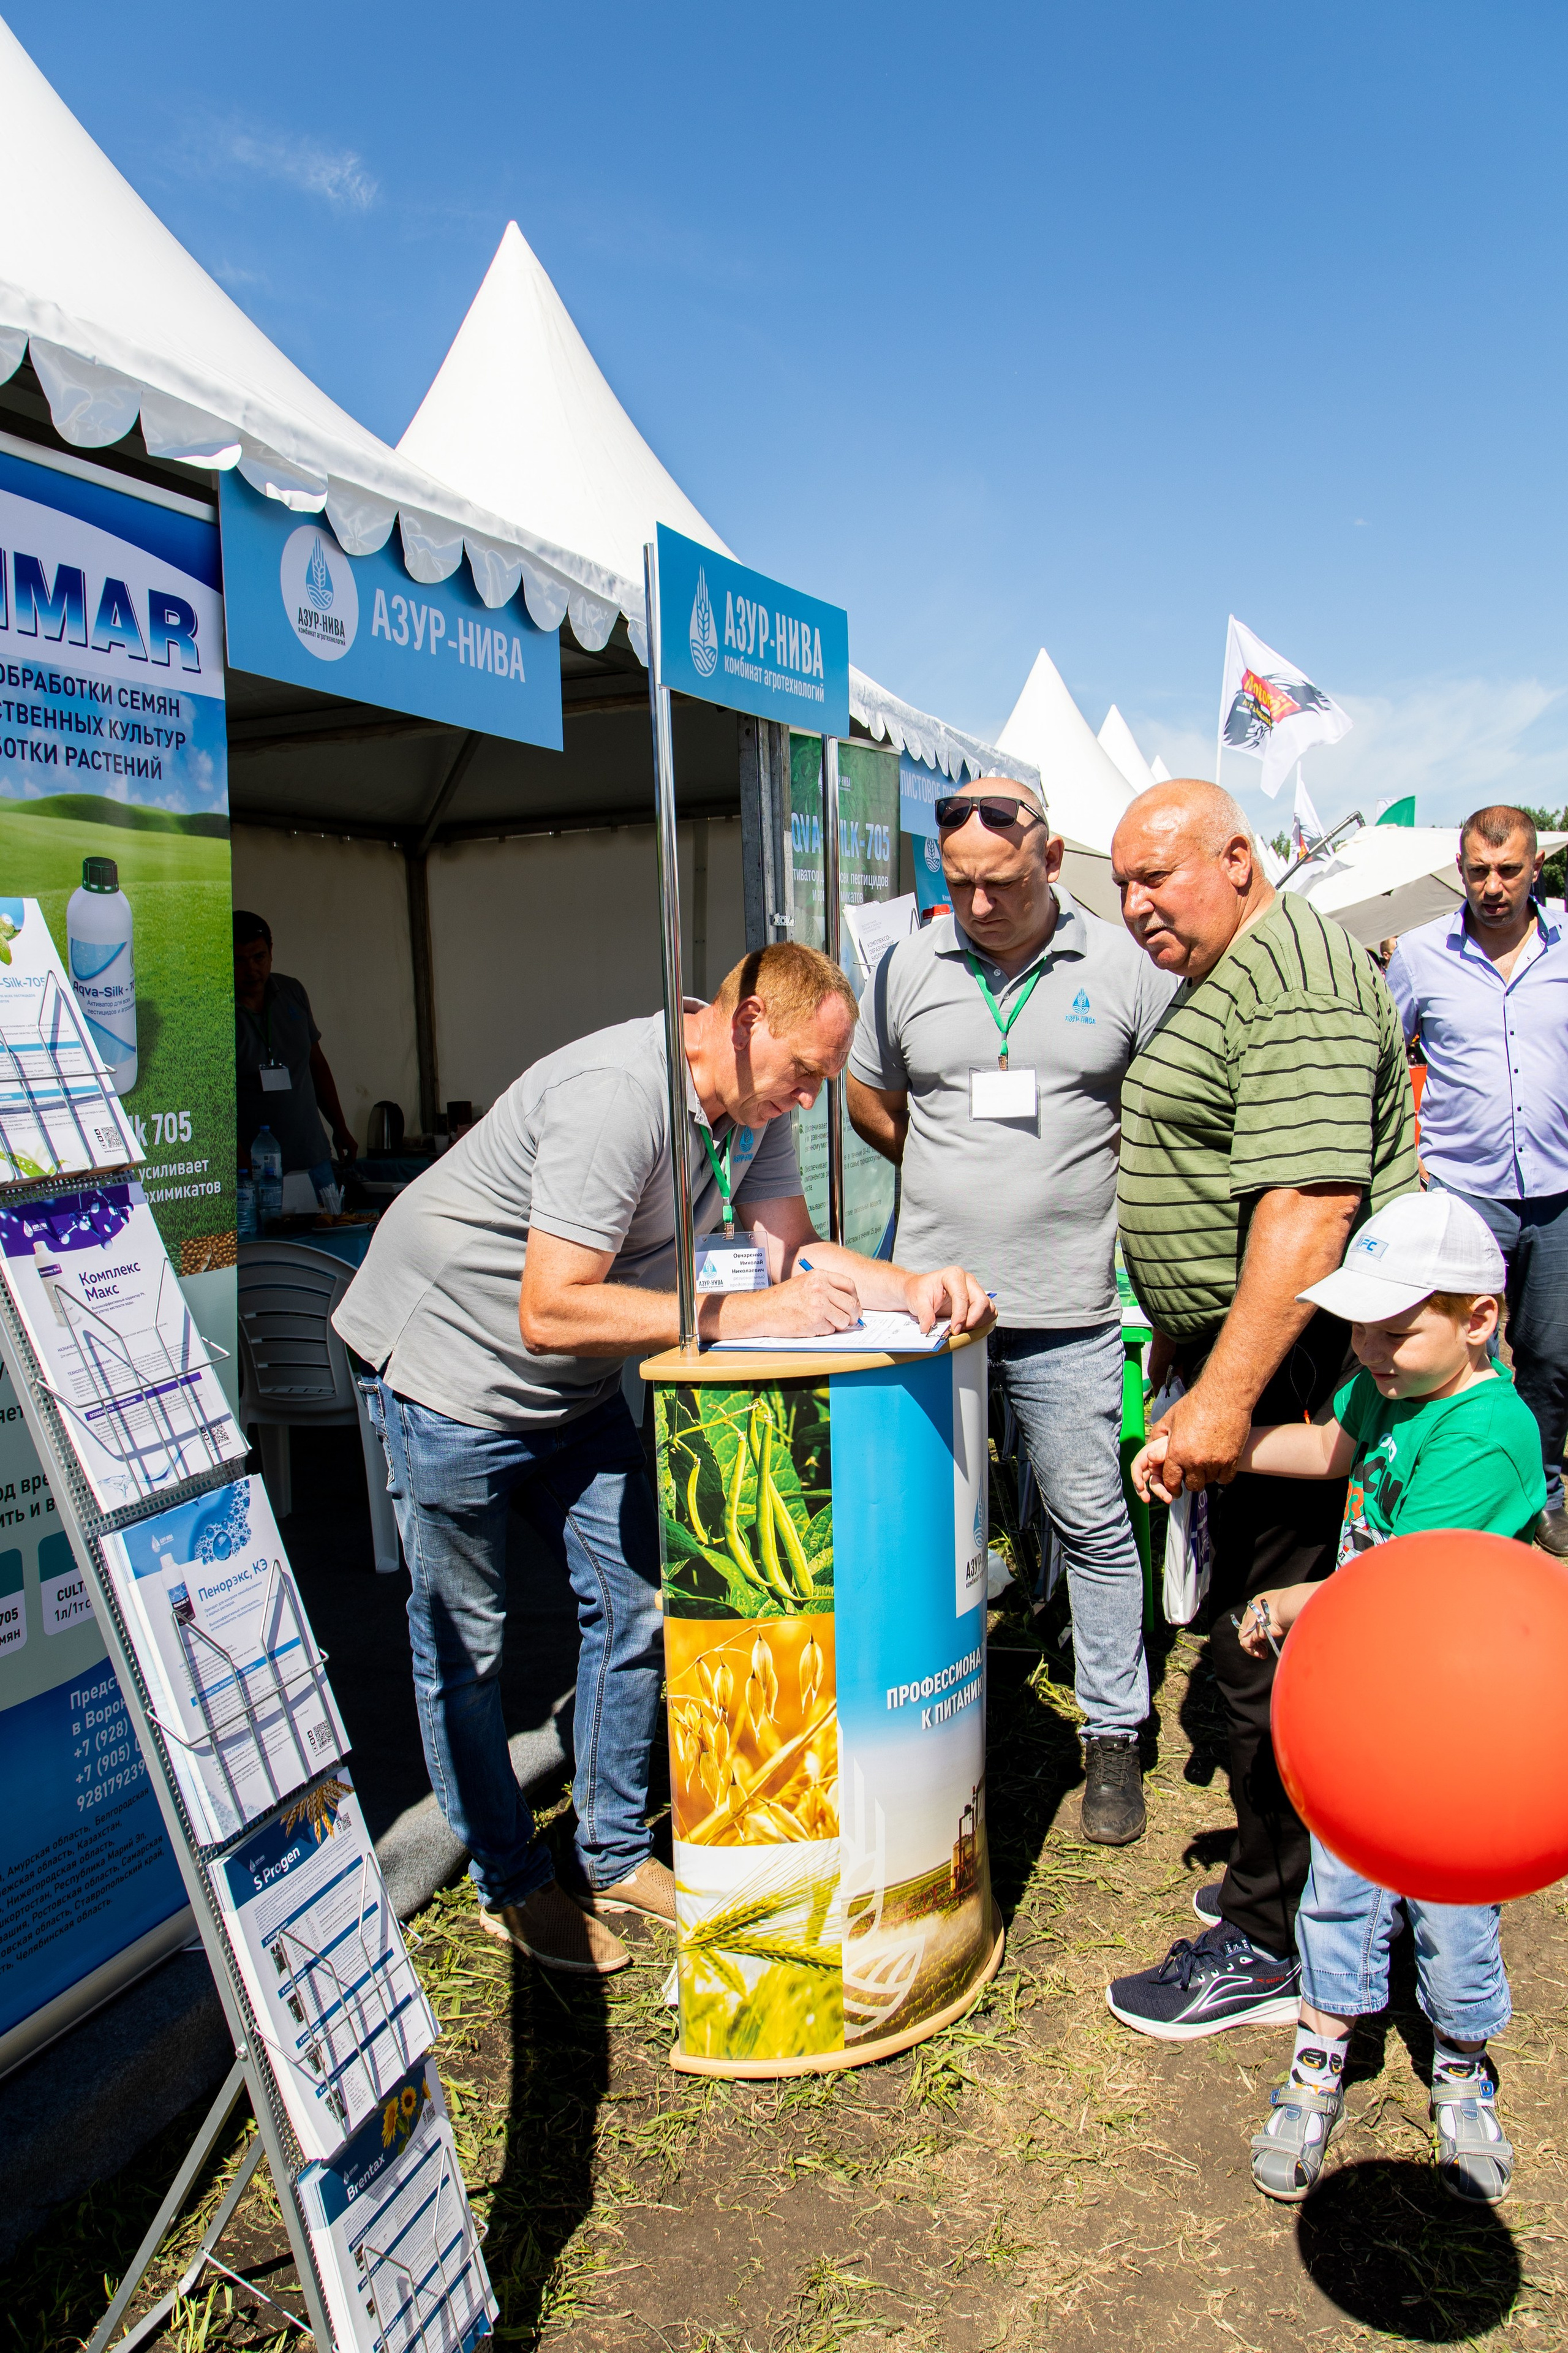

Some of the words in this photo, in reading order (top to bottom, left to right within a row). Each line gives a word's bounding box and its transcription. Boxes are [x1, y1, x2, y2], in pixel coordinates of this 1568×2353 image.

[0, 547, 201, 673] MAR
[298, 607, 345, 638] АЗУР-НИВА
[298, 627, 316, 636] комбинат
[317, 632, 346, 646] агротехнологий
[372, 588, 526, 683] АЗУР-НИВА
[725, 591, 824, 679] АЗУР-НИВА
[725, 655, 762, 676] комбинат
[764, 668, 824, 703] агротехнологий
[118, 688, 180, 718] СЕМЯН
[0, 700, 104, 736] ТВЕННЫХ
[109, 719, 186, 750] КУЛЬТУР
[0, 737, 58, 766] ОТКИ
[66, 747, 162, 780] РАСТЕНИЙ
[74, 981, 123, 997] Aqva-Silk
[151, 1111, 192, 1146] 705
[138, 1160, 209, 1184] усиливает
[144, 1181, 221, 1204] охимикатов
[79, 1262, 141, 1286] Комплекс
[85, 1284, 119, 1302] Макс
[198, 1570, 252, 1602] Пенорэкс,
[252, 1558, 268, 1575] КЭ
[966, 1553, 983, 1581] АЗУР-
[58, 1581, 86, 1602] CULT
[72, 1722, 81, 1736] в
[74, 1739, 90, 1758] +7
[95, 1717, 129, 1752] (928)
[921, 1709, 932, 1731] К
[76, 1764, 92, 1783] +7
[97, 1742, 130, 1777] (905)
[77, 1758, 148, 1812] 928179239
[7, 1846, 50, 1877] Амурская
[53, 1826, 91, 1849] область,
[95, 1788, 149, 1826] Белгородская
[0, 1871, 34, 1898] ежская
[37, 1849, 75, 1874] область,
[77, 1820, 123, 1851] Казахстан,
[7, 1860, 77, 1908] Нижегородская
[80, 1840, 115, 1864] область,
[32, 1886, 82, 1923] Ростовская
[85, 1866, 119, 1890] область,
[122, 1835, 162, 1867] Самарская
[55, 1858, 105, 1894] Республика
[108, 1838, 134, 1862] Марий
[135, 1832, 147, 1843] Эл,
[254, 1876, 262, 1890] S
[262, 1847, 301, 1884] Progen
[36, 1909, 72, 1936] область,
[75, 1860, 143, 1910] Ставропольский
[145, 1846, 164, 1867] край,
[16, 1919, 74, 1961] Челябинская
[77, 1898, 113, 1924] область.
[346, 2153, 385, 2202] Brentax
